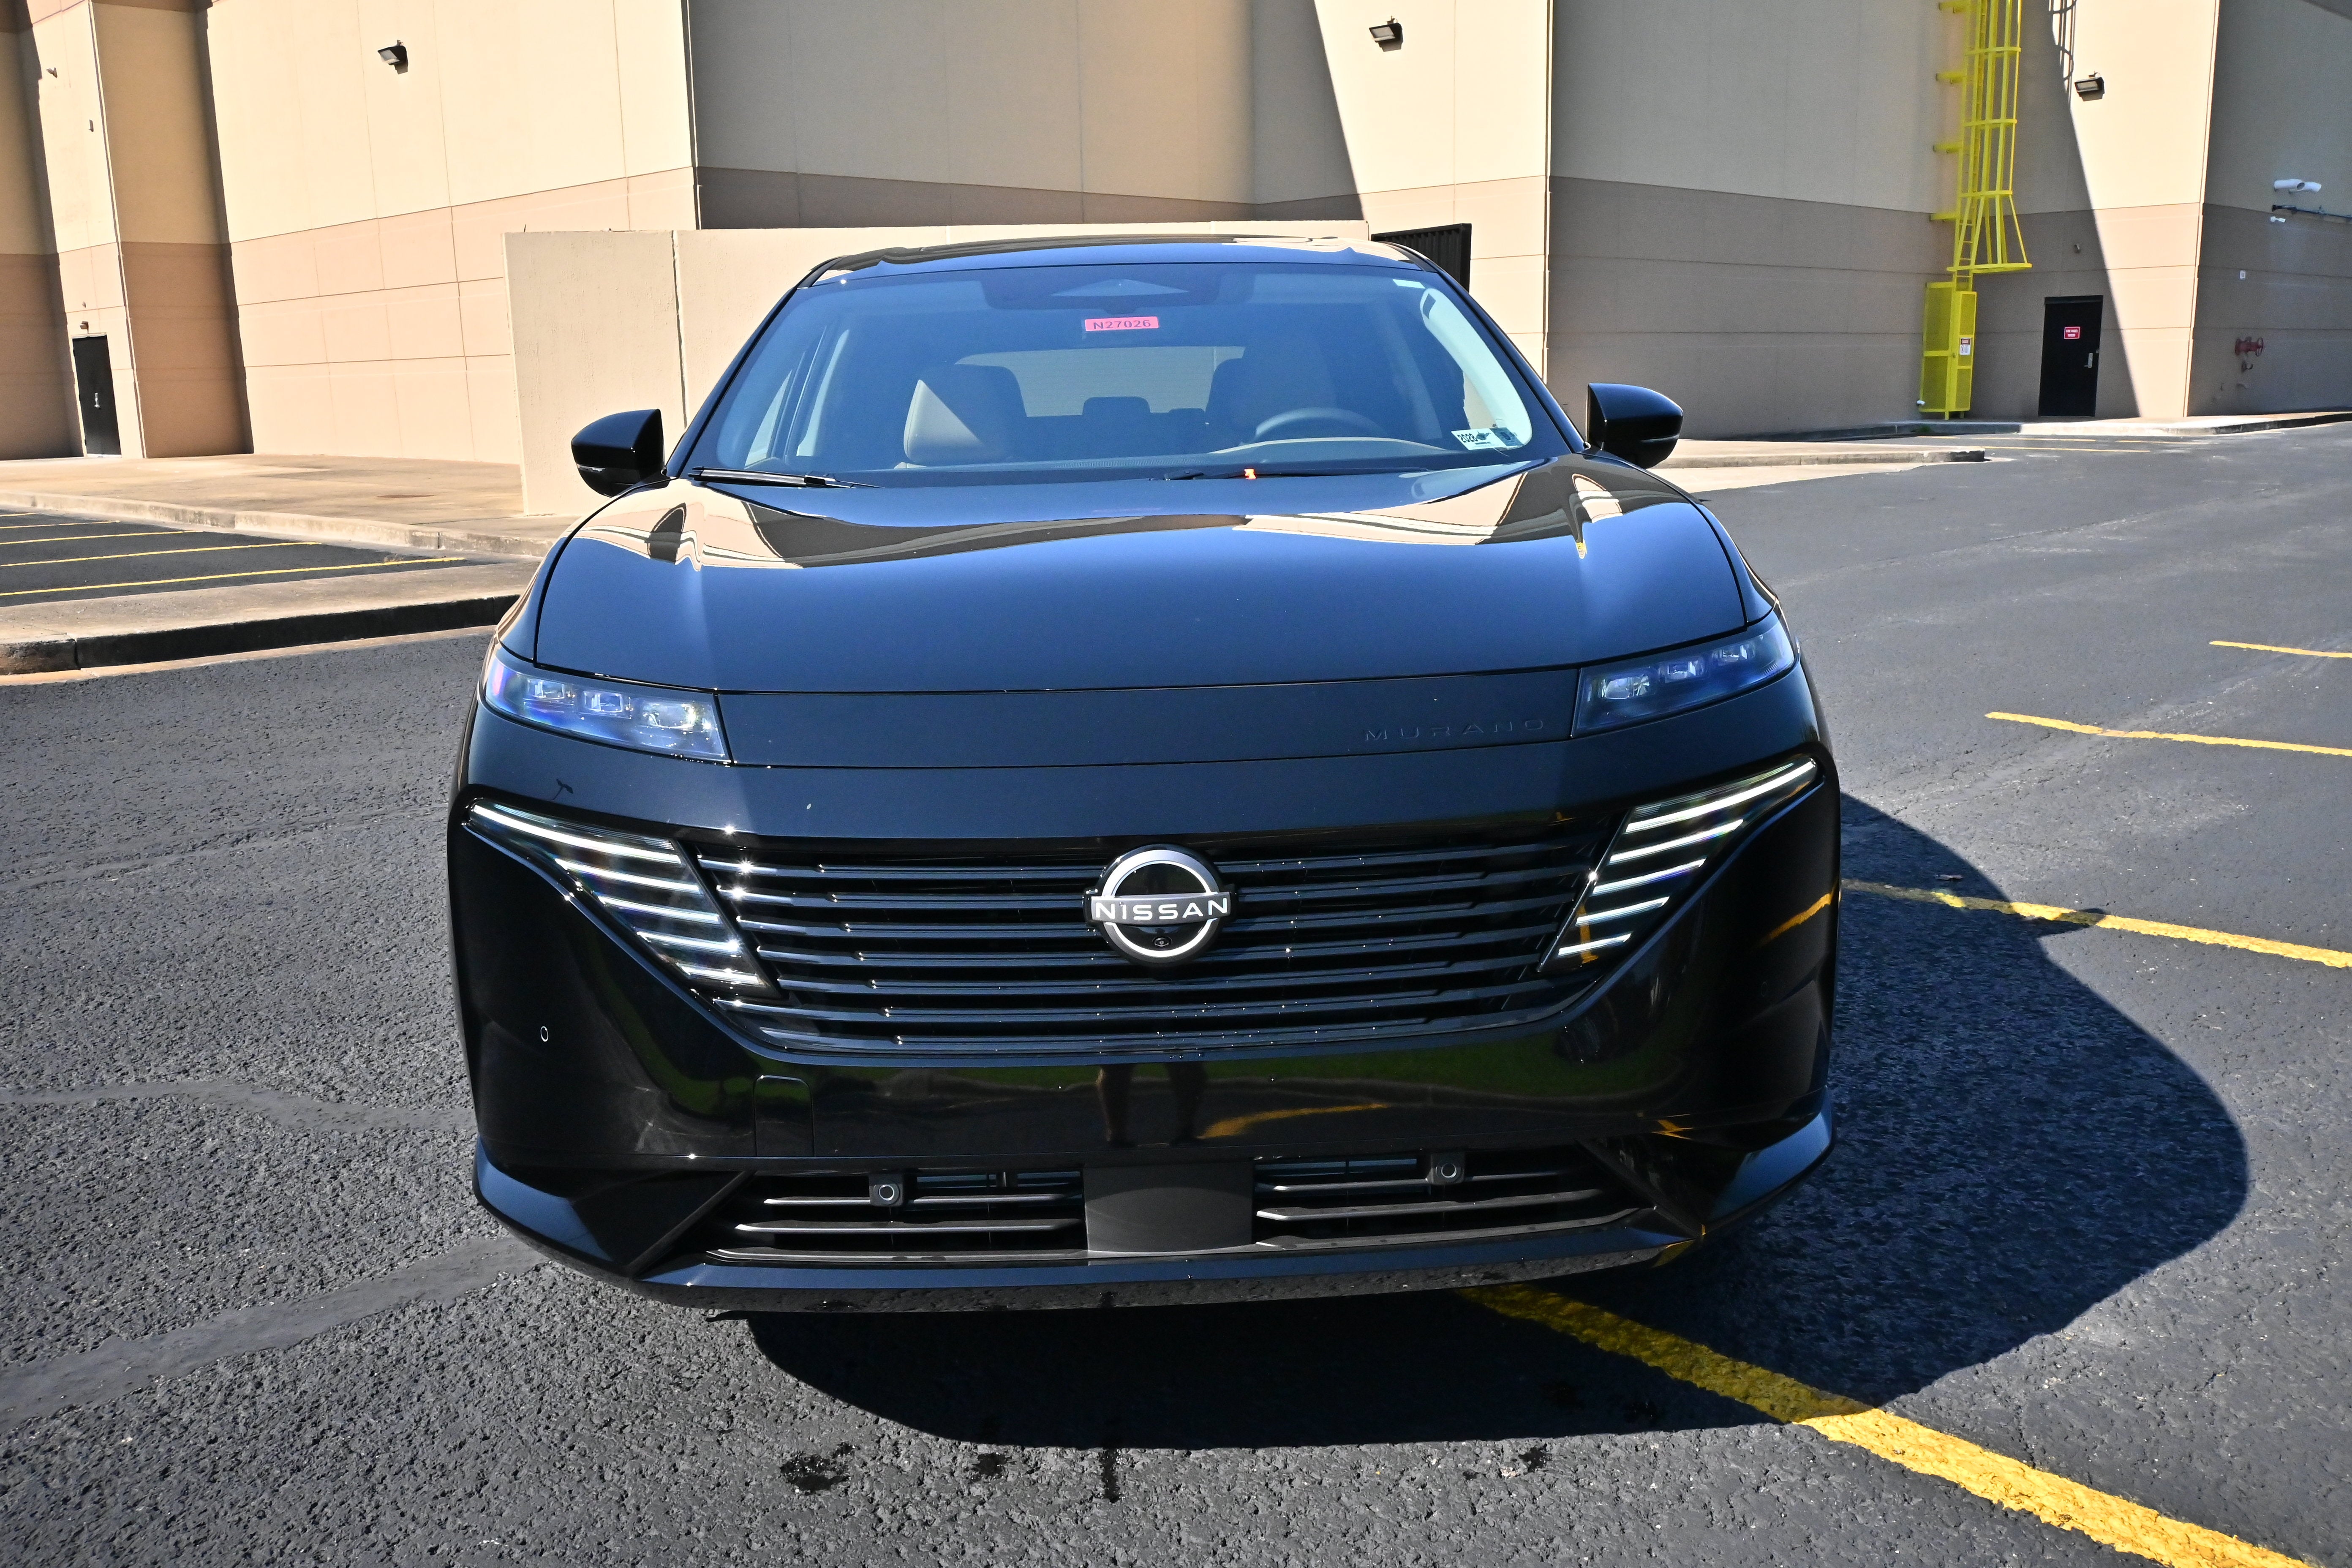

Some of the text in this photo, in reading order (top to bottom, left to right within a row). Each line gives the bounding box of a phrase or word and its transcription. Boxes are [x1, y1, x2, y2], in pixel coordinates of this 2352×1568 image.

[1093, 320, 1151, 329] N27026
[1365, 719, 1543, 740] MURANO
[1096, 898, 1228, 920] NISSAN
